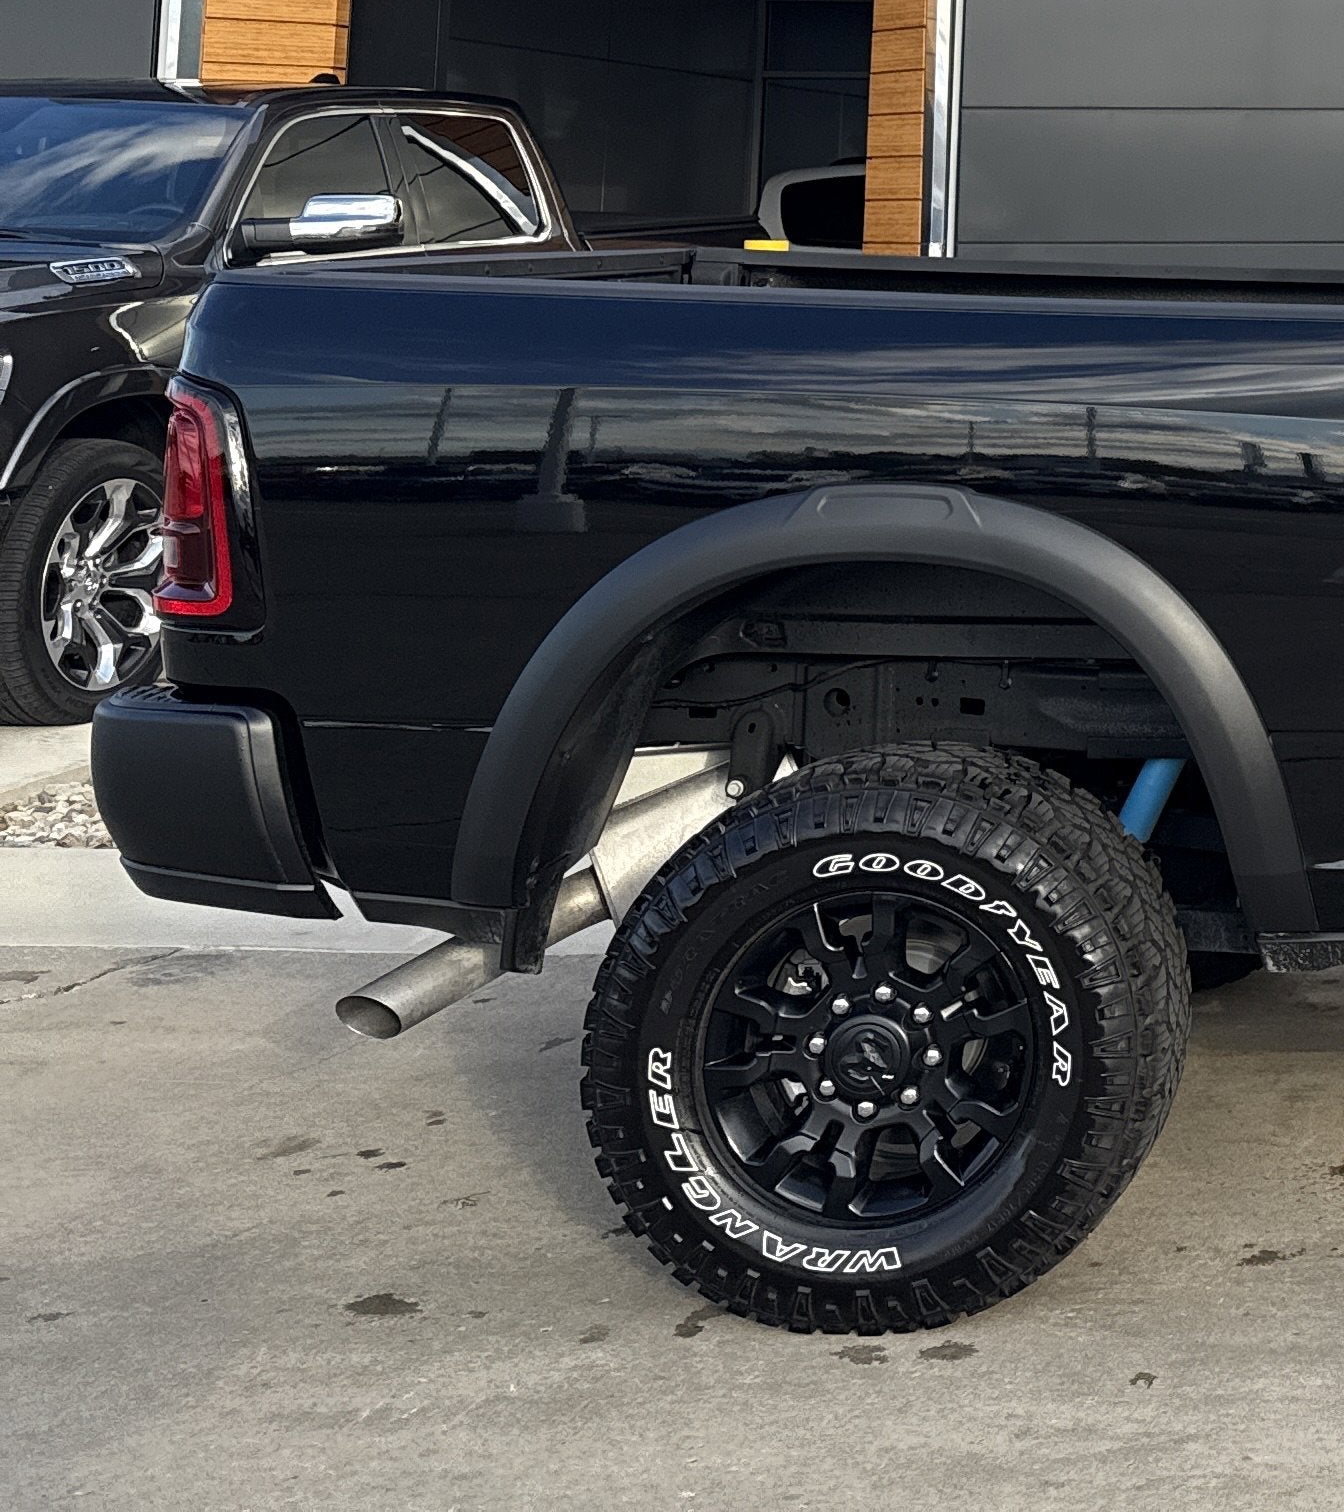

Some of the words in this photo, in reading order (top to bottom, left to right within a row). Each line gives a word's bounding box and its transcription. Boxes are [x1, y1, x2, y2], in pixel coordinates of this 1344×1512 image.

[62, 260, 123, 275] 1500
[812, 852, 1074, 1087] GOODYEAR
[648, 1047, 902, 1273] WRANGLER
